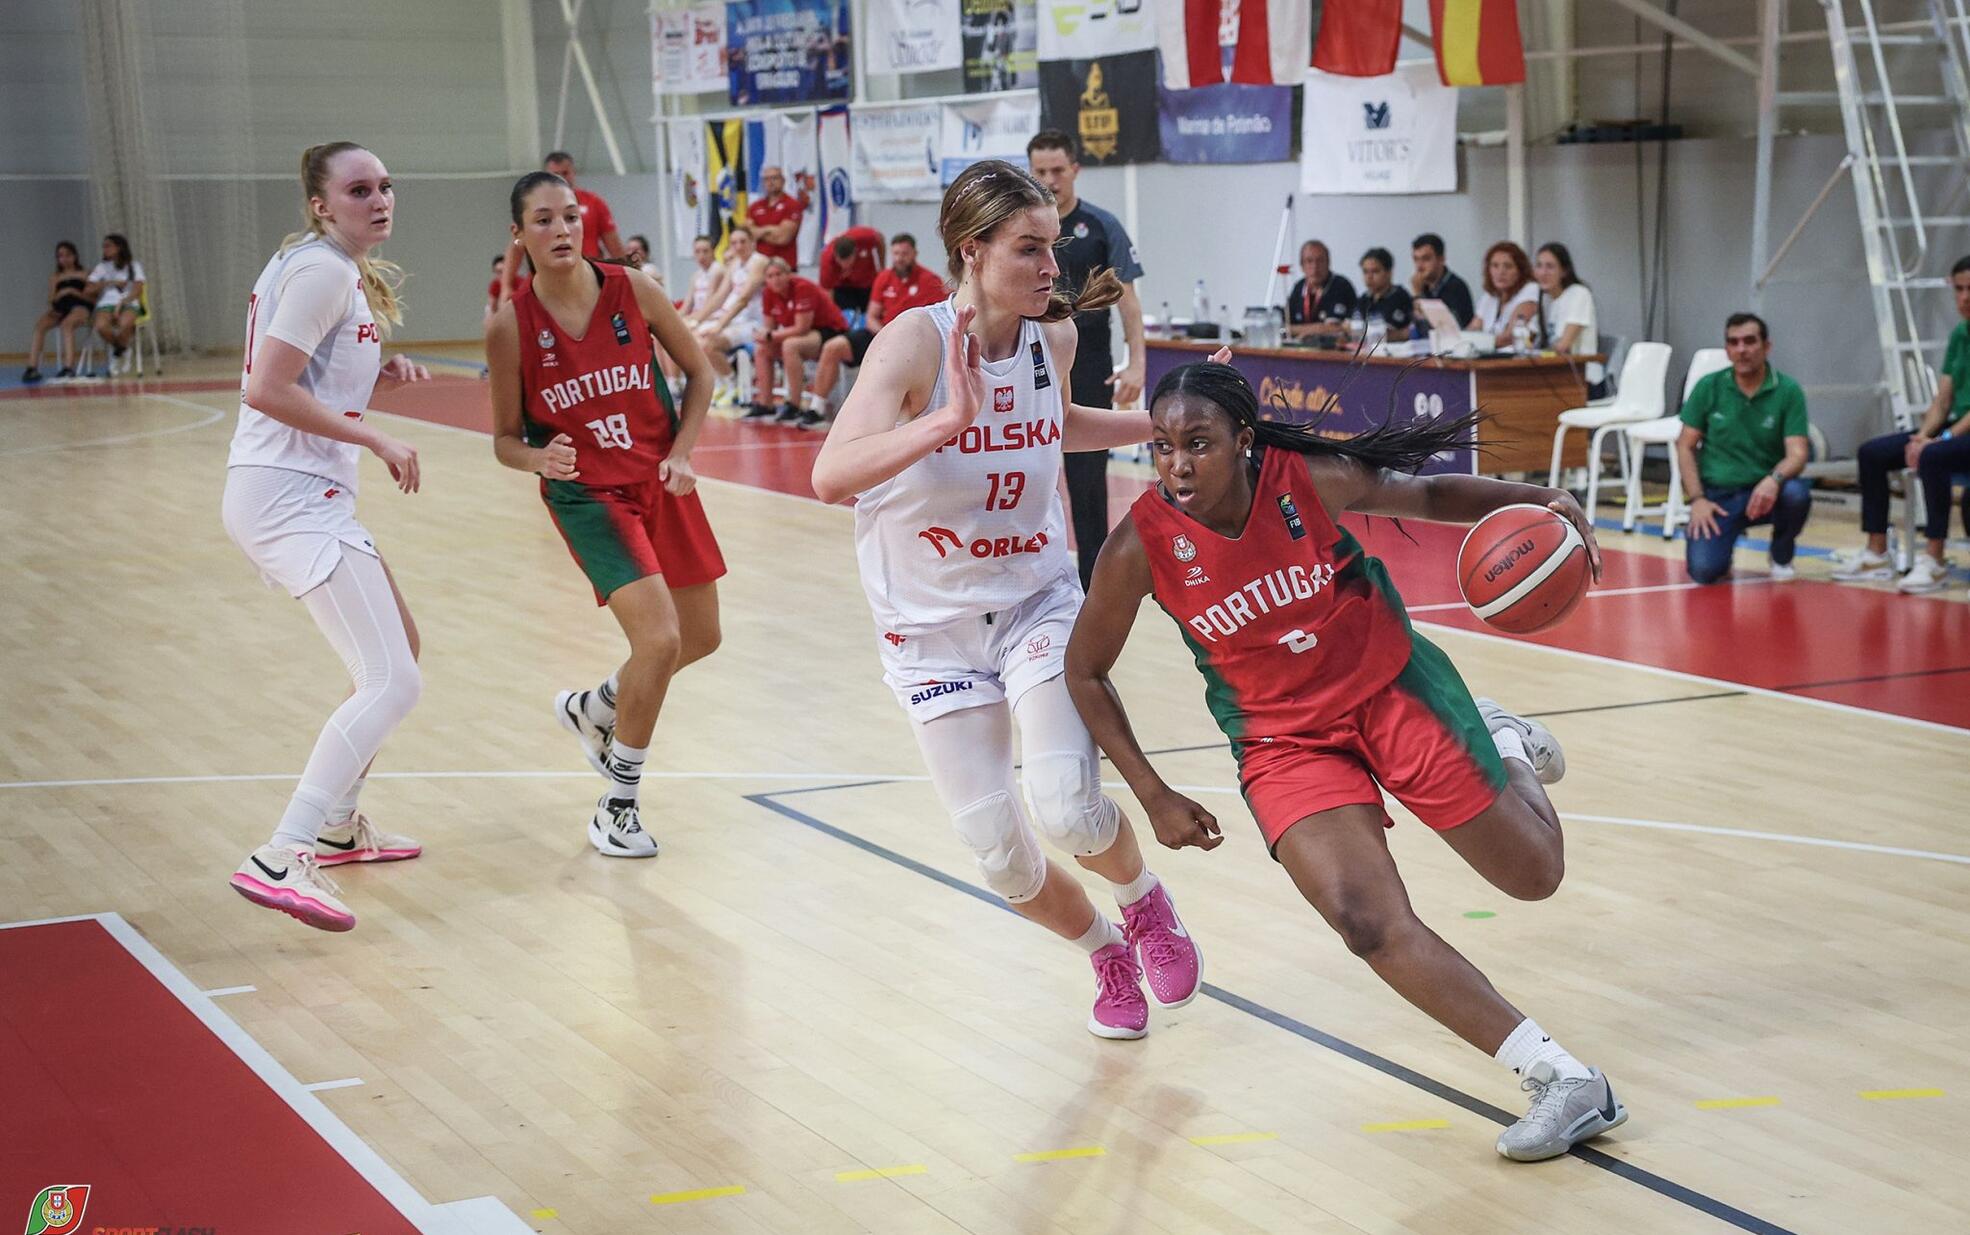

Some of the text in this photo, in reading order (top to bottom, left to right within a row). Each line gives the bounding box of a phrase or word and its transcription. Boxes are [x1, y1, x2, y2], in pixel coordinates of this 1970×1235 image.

[540, 364, 651, 414] PORTUGAL
[585, 413, 634, 450] 28
[986, 471, 1026, 511] 13
[1484, 539, 1535, 583] molten
[1184, 575, 1211, 587] DHIKA
[911, 681, 973, 705] SUZUKI
